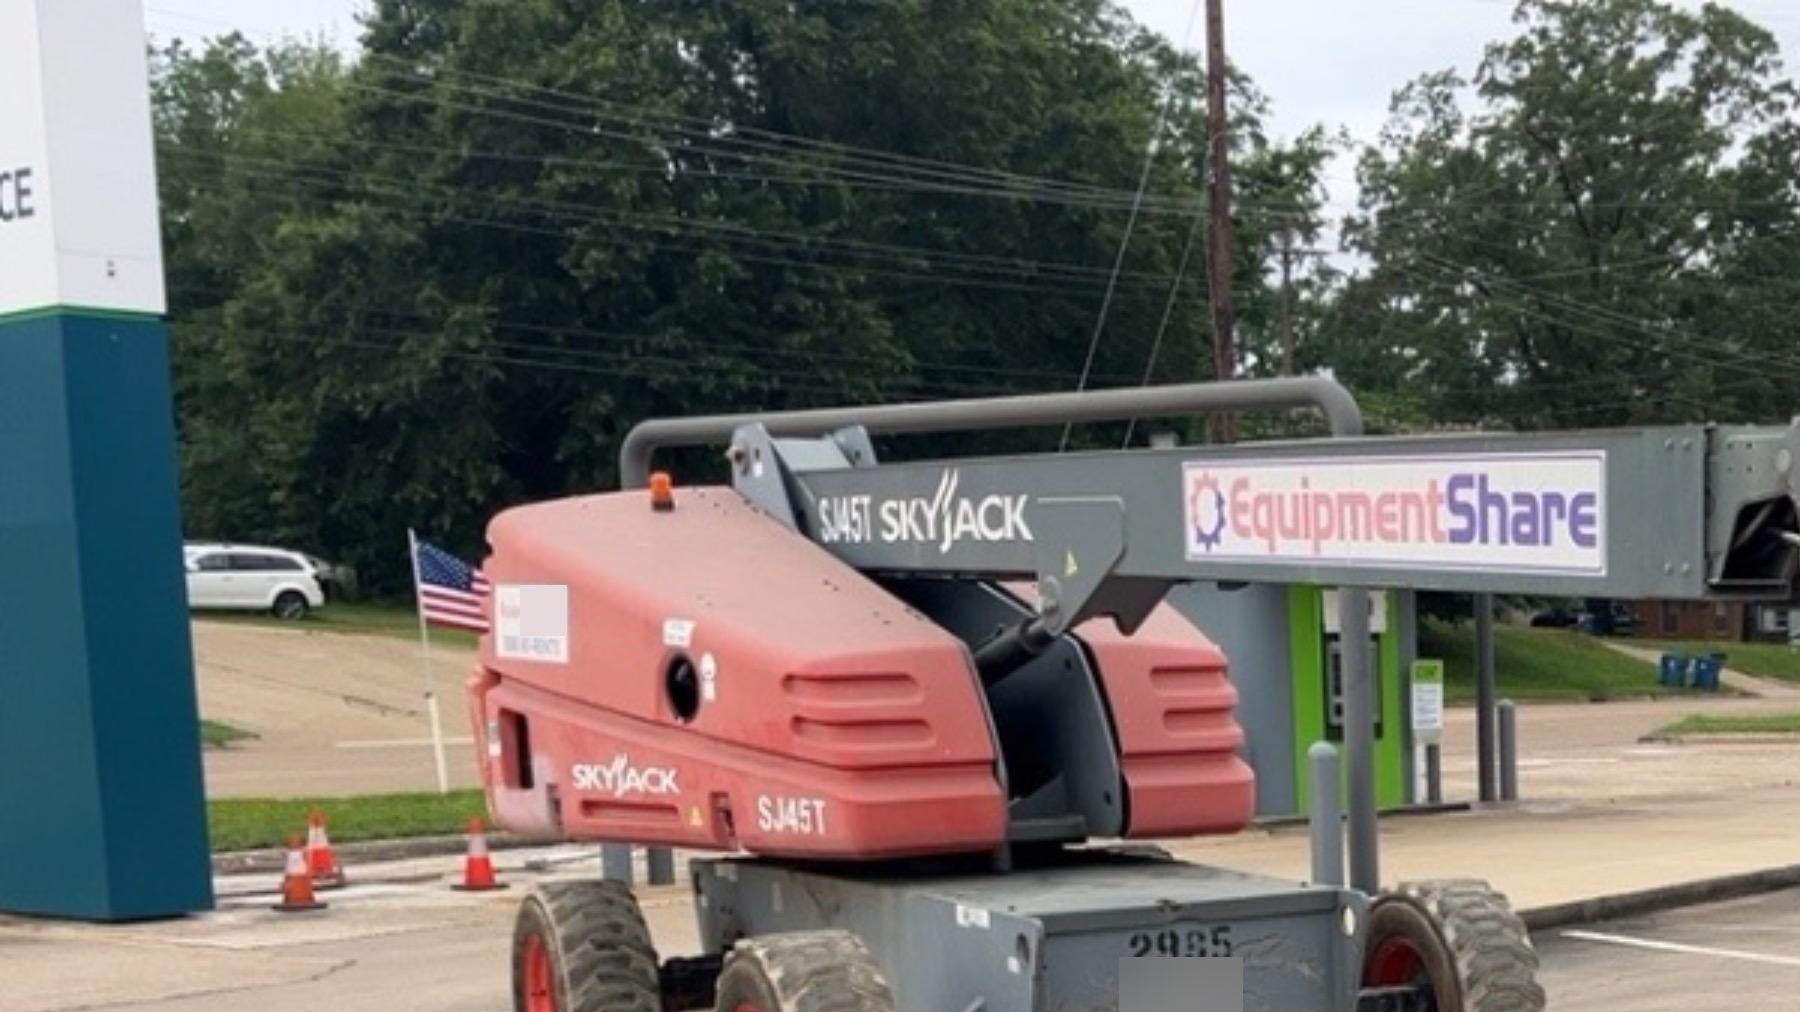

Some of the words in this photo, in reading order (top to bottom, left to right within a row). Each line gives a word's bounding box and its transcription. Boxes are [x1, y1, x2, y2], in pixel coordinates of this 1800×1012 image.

[818, 494, 872, 544] SJ45T
[879, 467, 1034, 554] SKYJACK
[1229, 472, 1599, 555] EquipmentShare
[572, 752, 681, 798] SKYJACK
[757, 794, 826, 836] SJ45T
